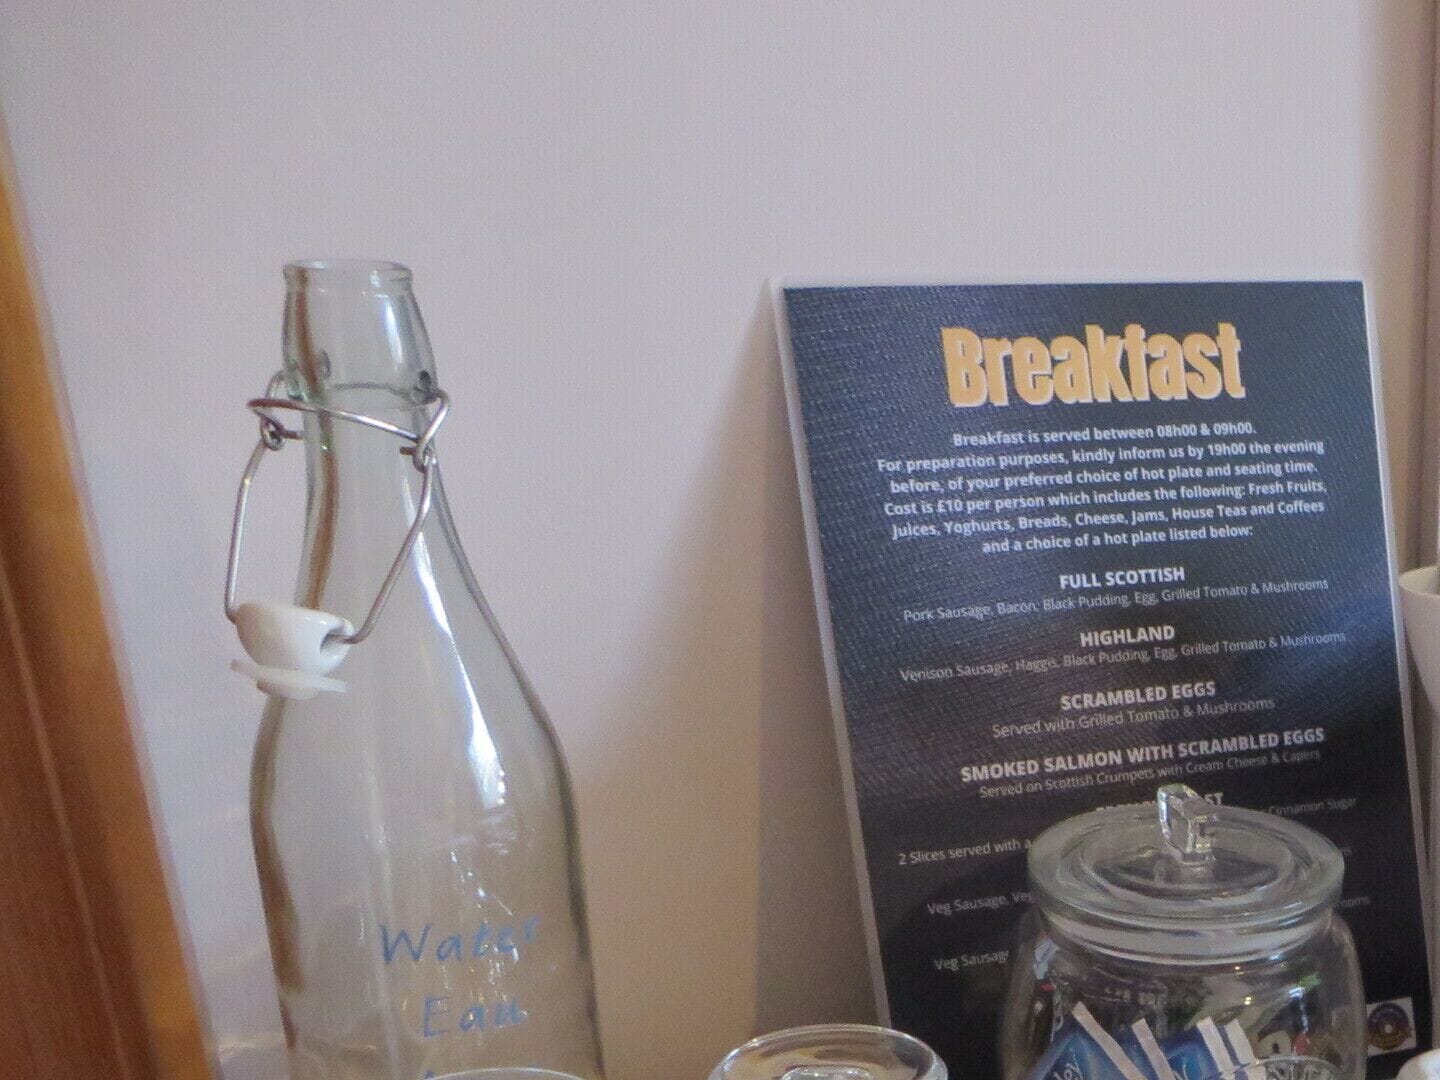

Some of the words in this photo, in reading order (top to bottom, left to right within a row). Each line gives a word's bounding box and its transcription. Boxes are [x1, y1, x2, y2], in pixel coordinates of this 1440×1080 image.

[940, 321, 1246, 408] Breakfast
[953, 431, 1024, 446] Breakfast
[1028, 431, 1039, 442] is
[1044, 428, 1090, 441] served
[1094, 425, 1153, 440] between
[1157, 424, 1197, 436] 08h00
[1201, 424, 1211, 436] &
[1214, 422, 1256, 435] 09h00.
[877, 458, 900, 472] For
[906, 454, 995, 472] preparation
[999, 453, 1069, 468] purposes,
[1073, 449, 1115, 464] kindly
[1119, 446, 1165, 460] inform
[1169, 447, 1185, 457] us
[1188, 445, 1204, 460] by
[1208, 442, 1246, 456] 19h00
[1250, 441, 1270, 454] the
[1275, 440, 1324, 456] evening
[891, 478, 944, 493] before,
[949, 477, 963, 490] of
[967, 477, 1000, 492] your
[1005, 472, 1072, 489] preferred
[1077, 469, 1121, 483] choice
[1125, 467, 1138, 480] of
[1141, 466, 1165, 480] hot
[1169, 464, 1202, 481] plate
[1206, 463, 1231, 476] and
[1235, 461, 1281, 477] seating
[1285, 460, 1318, 473] time.
[885, 502, 917, 515] Cost
[922, 501, 933, 514] is
[937, 500, 963, 513] £10
[967, 500, 990, 514] per
[995, 496, 1044, 513] person
[1048, 491, 1090, 506] which
[1094, 490, 1151, 503] includes
[1155, 487, 1176, 500] the
[1180, 484, 1246, 499] following:
[1249, 481, 1283, 495] Fresh
[1287, 479, 1327, 493] Fruits,
[892, 523, 940, 540] Juices,
[944, 519, 1015, 536] Yoghurts,
[1019, 515, 1072, 529] Breads,
[1075, 511, 1128, 525] Cheese,
[1131, 510, 1168, 525] Jams,
[1173, 507, 1213, 519] House
[1217, 505, 1247, 517] Teas
[1250, 503, 1274, 515] and
[1278, 501, 1324, 514] Coffees
[983, 537, 1010, 553] and
[1014, 541, 1022, 550] a
[1026, 535, 1071, 548] choice
[1075, 534, 1088, 546] of
[1092, 537, 1100, 546] a
[1105, 531, 1128, 544] hot
[1132, 528, 1166, 546] plate
[1169, 527, 1206, 540] listed
[1210, 525, 1253, 538] below:
[1060, 574, 1101, 590] FULL
[1106, 567, 1185, 587] SCOTTISH
[903, 610, 933, 622] Pork
[937, 605, 993, 620] Sausage,
[1043, 597, 1075, 610] Black
[1135, 591, 1158, 605] Egg,
[1162, 587, 1200, 601] Grilled
[1204, 585, 1247, 598] Tomato
[1250, 583, 1259, 594] &
[1263, 579, 1329, 593] Mushrooms
[1080, 625, 1175, 648] HIGHLAND
[900, 667, 953, 682] Venison
[956, 662, 1012, 676] Sausage,
[1063, 652, 1096, 665] Black
[1181, 641, 1219, 656] Grilled
[1223, 640, 1266, 652] Tomato
[1269, 637, 1278, 647] &
[1281, 632, 1346, 646] Mushrooms
[1060, 685, 1167, 710] SCRAMBLED
[1172, 681, 1216, 698] EGGS
[992, 721, 1041, 738] Served
[1044, 718, 1075, 732] with
[1078, 712, 1123, 728] Grilled
[1128, 706, 1179, 724] Tomato
[1183, 706, 1193, 718] &
[1197, 697, 1276, 715] Mushrooms
[960, 760, 1040, 783] SMOKED
[1044, 750, 1122, 772] SALMON
[1126, 744, 1174, 764] WITH
[1178, 733, 1279, 757] SCRAMBLED
[1284, 728, 1324, 745] EGGS
[979, 782, 1024, 799] Served
[1026, 781, 1042, 792] on
[1045, 774, 1093, 790] Scottish
[1097, 768, 1156, 785] Crumpets
[1157, 765, 1182, 779] with
[1186, 761, 1223, 775] Cream
[1227, 755, 1268, 769] Cheese
[1271, 754, 1281, 764] &
[1284, 750, 1321, 763] Capers
[899, 853, 907, 865] 2
[909, 850, 946, 865] Slices
[949, 843, 991, 858] served
[994, 839, 1021, 853] with
[927, 903, 952, 916] Veg
[377, 916, 543, 964] Water
[934, 958, 959, 971] Veg
